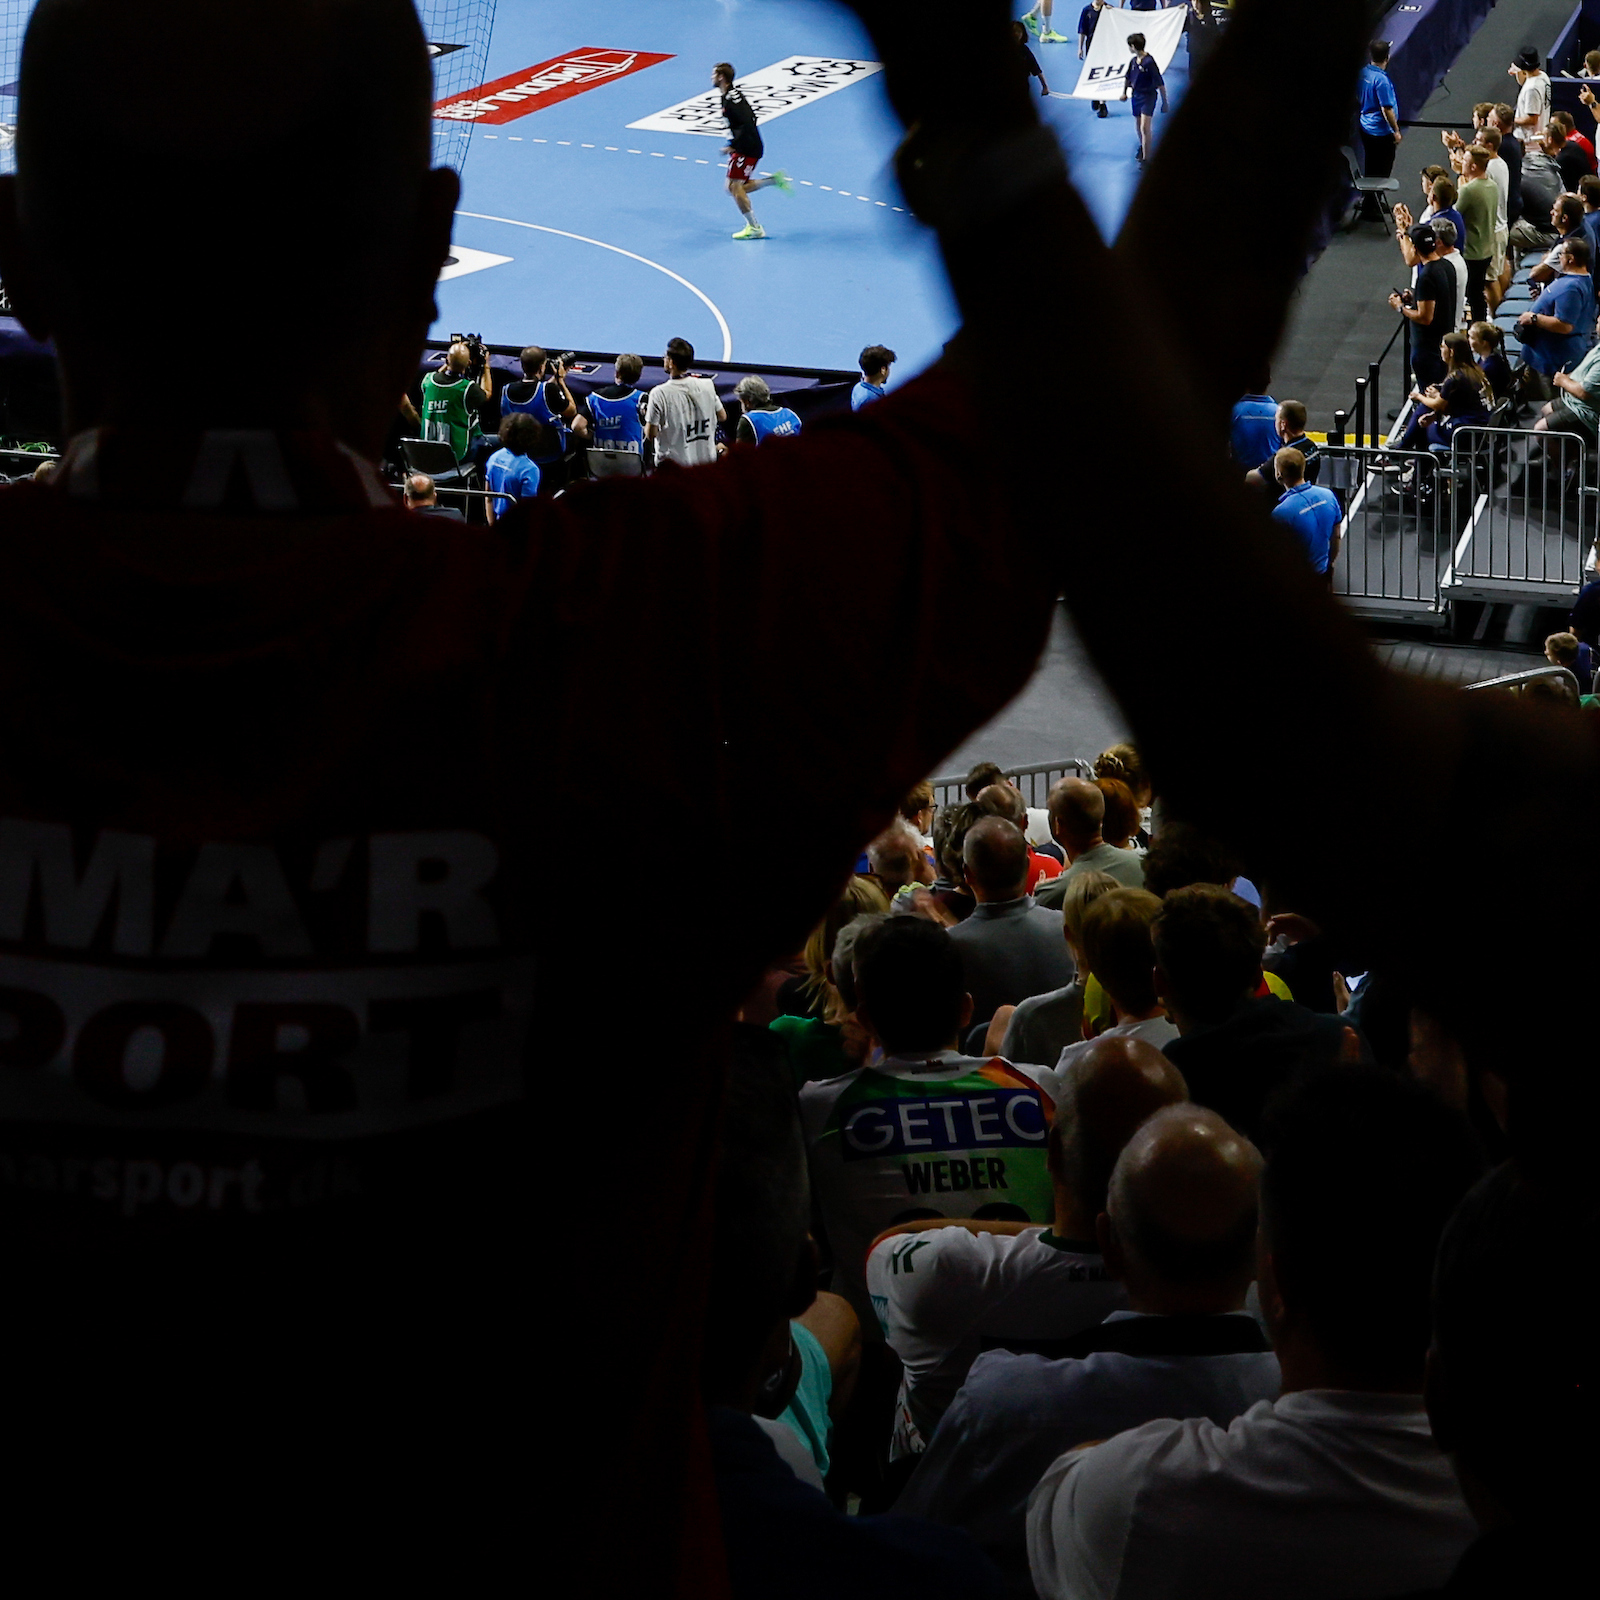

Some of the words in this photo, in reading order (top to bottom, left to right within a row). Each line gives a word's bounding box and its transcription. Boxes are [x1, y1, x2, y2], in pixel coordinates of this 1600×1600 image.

[1087, 64, 1127, 82] EH
[427, 399, 449, 413] EHF
[843, 1094, 1047, 1153] GETEC
[901, 1157, 1009, 1196] WEBER
